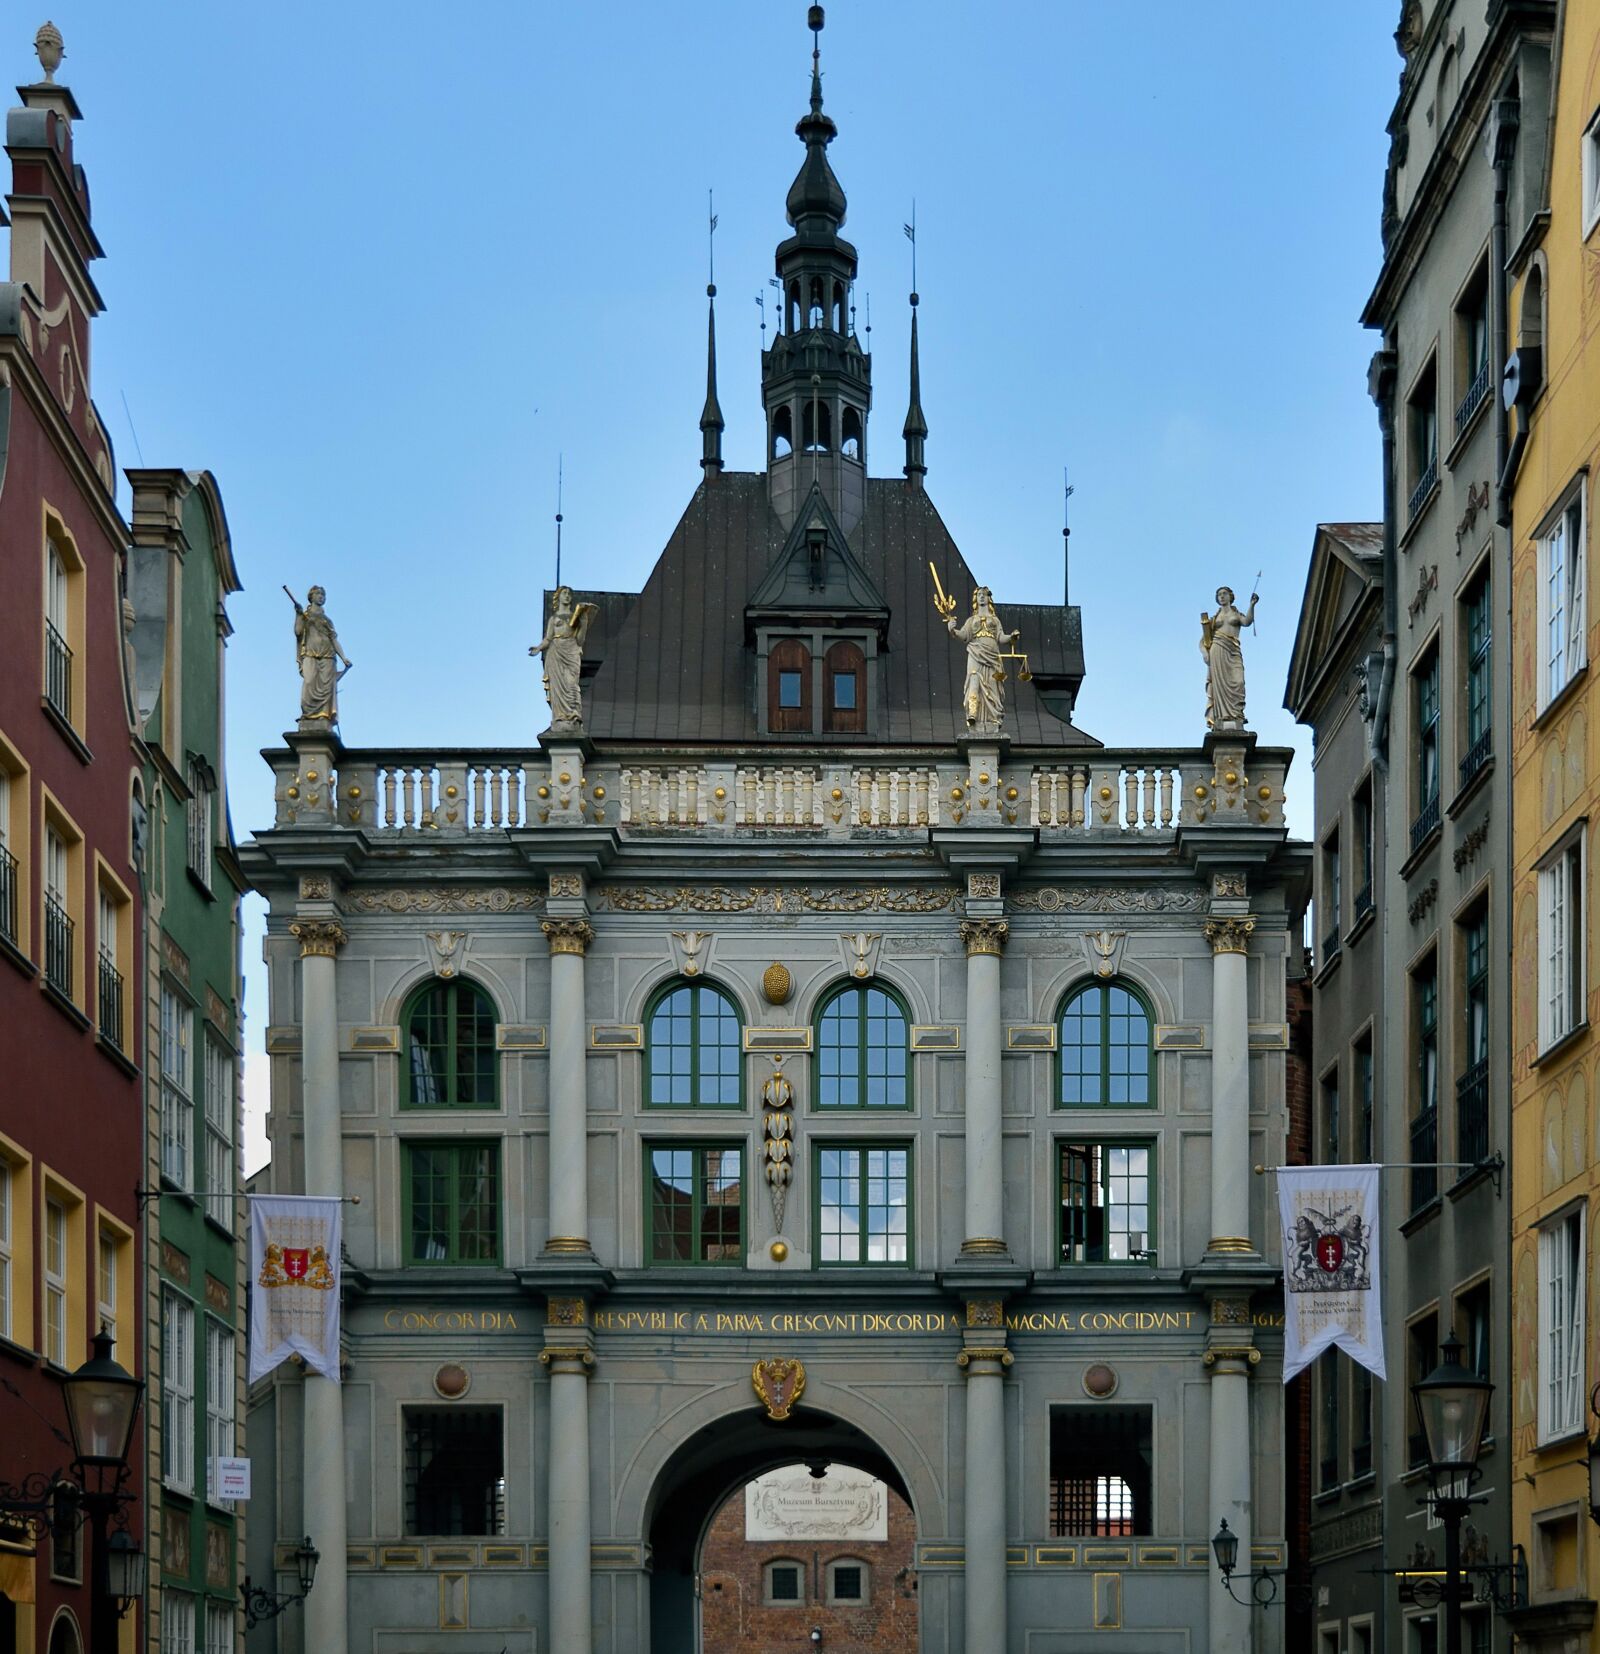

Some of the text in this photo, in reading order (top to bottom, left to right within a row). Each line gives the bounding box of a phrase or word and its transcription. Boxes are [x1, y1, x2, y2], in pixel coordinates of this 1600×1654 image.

[384, 1309, 518, 1329] CONCORDIA
[771, 1313, 861, 1331] CRESCVNT
[862, 1314, 960, 1331] DISCORDIA
[1080, 1311, 1196, 1330] CONCIDVNT
